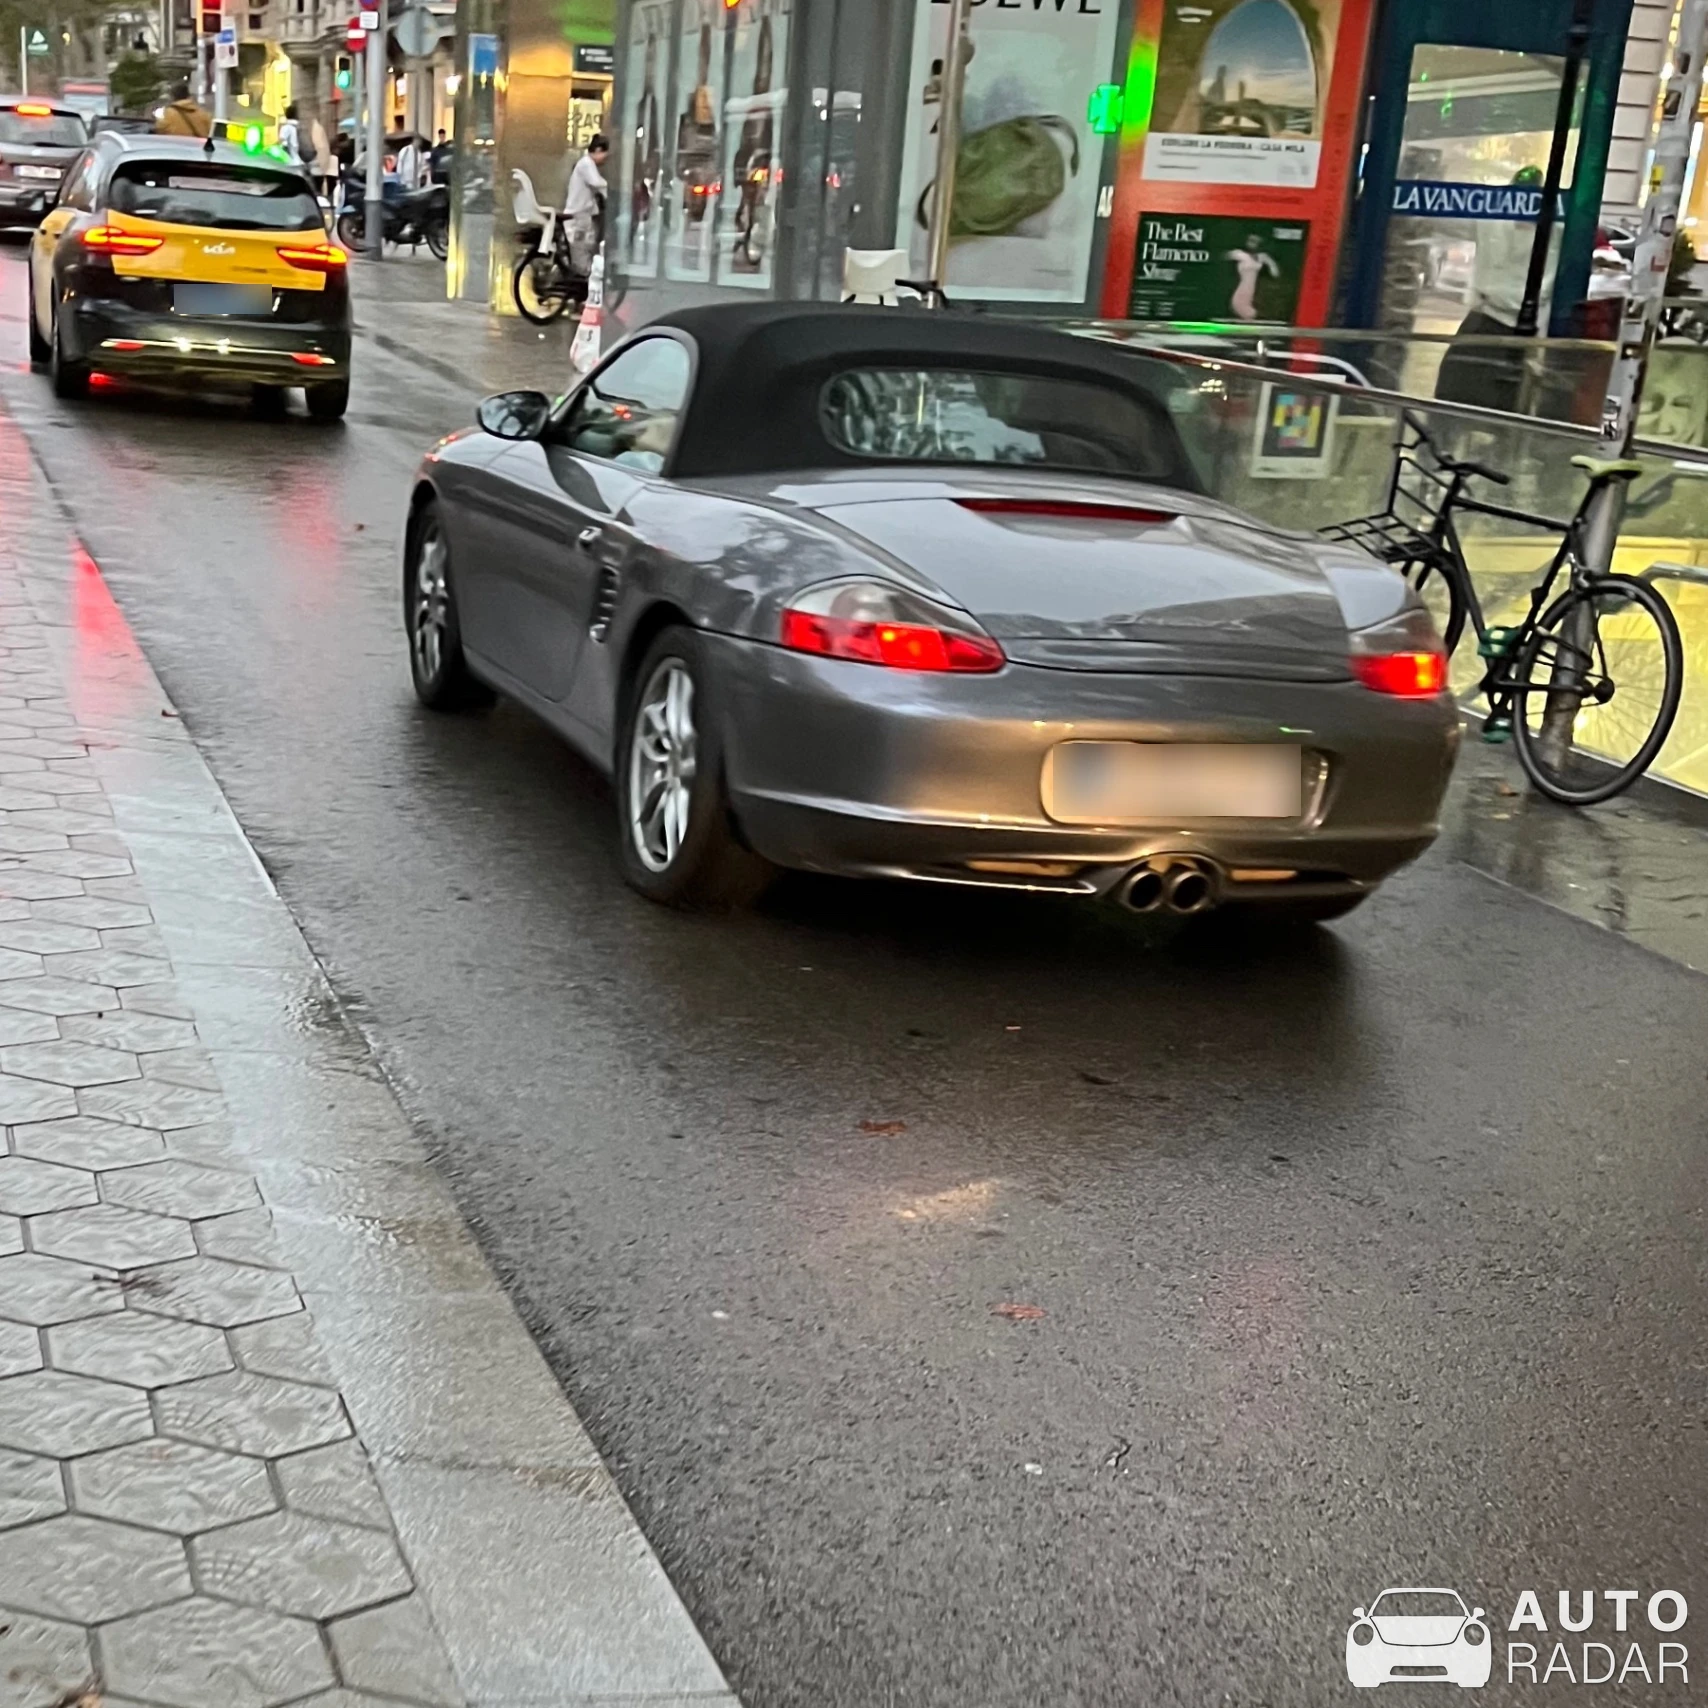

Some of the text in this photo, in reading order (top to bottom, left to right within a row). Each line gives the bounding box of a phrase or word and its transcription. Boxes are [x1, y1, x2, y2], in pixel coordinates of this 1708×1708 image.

[1392, 186, 1565, 216] LA VANGUARDA
[1145, 221, 1204, 242] The Best
[1142, 242, 1209, 262] Flamenco
